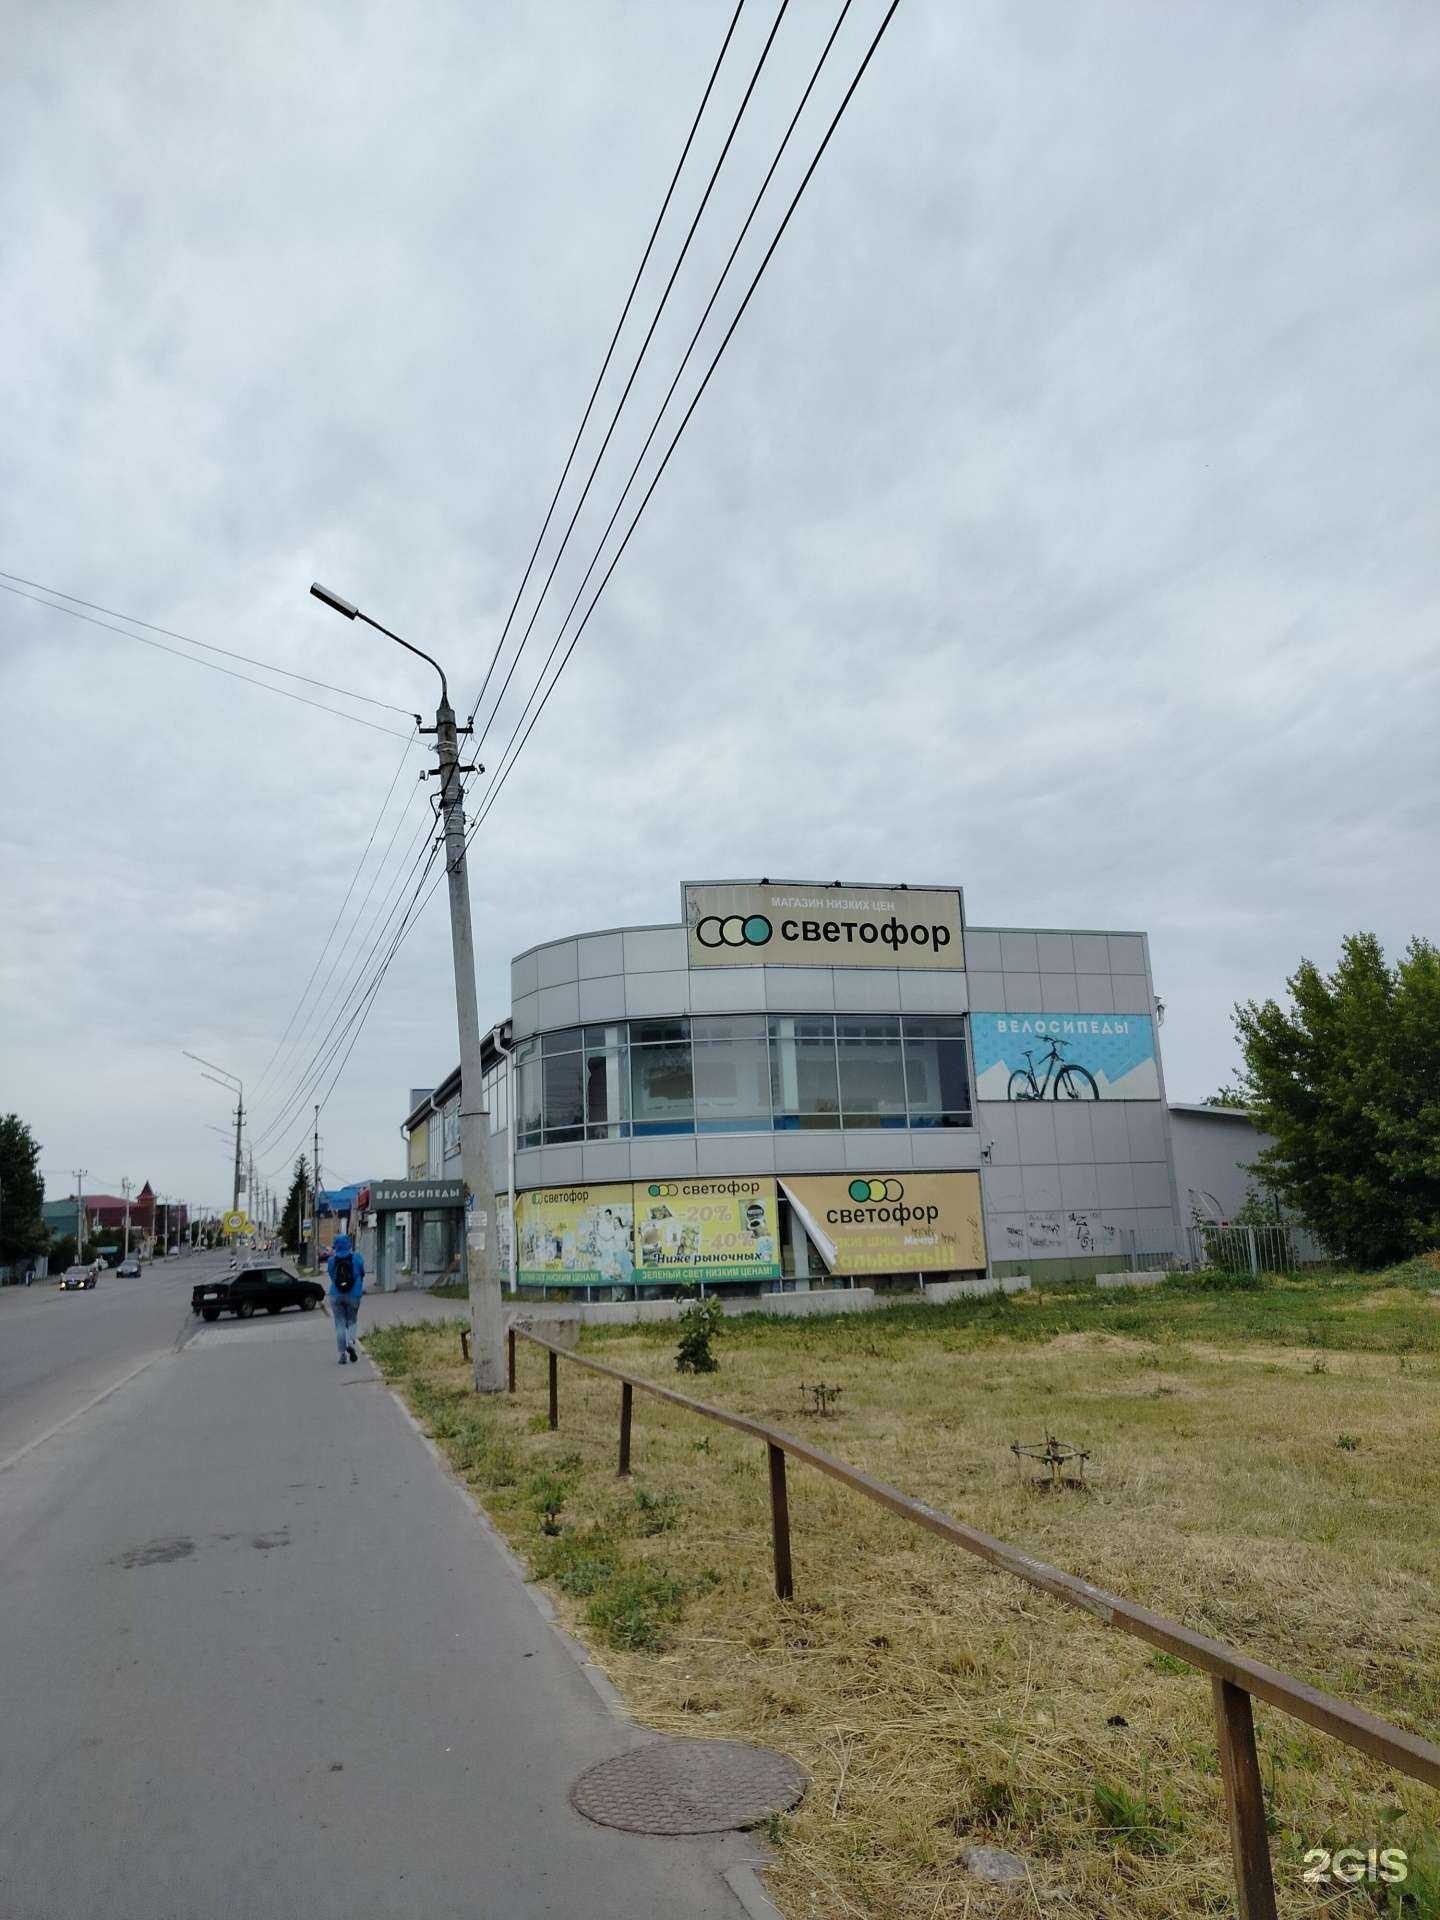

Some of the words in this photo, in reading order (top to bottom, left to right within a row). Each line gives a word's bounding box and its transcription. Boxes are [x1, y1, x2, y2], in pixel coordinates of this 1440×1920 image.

[771, 896, 824, 908] МАГАЗИН
[826, 899, 871, 911] НИЗКИХ
[872, 901, 895, 912] ЦЕН
[781, 917, 951, 952] светофор
[997, 1020, 1129, 1034] ВЕЛОСИПЕДЫ
[376, 1188, 460, 1200] ВЕЛОСИПЕДЫ
[682, 1180, 760, 1196] светофор
[543, 1189, 589, 1204] светофор
[826, 1202, 939, 1226] светофор
[694, 1252, 762, 1266] рыночных
